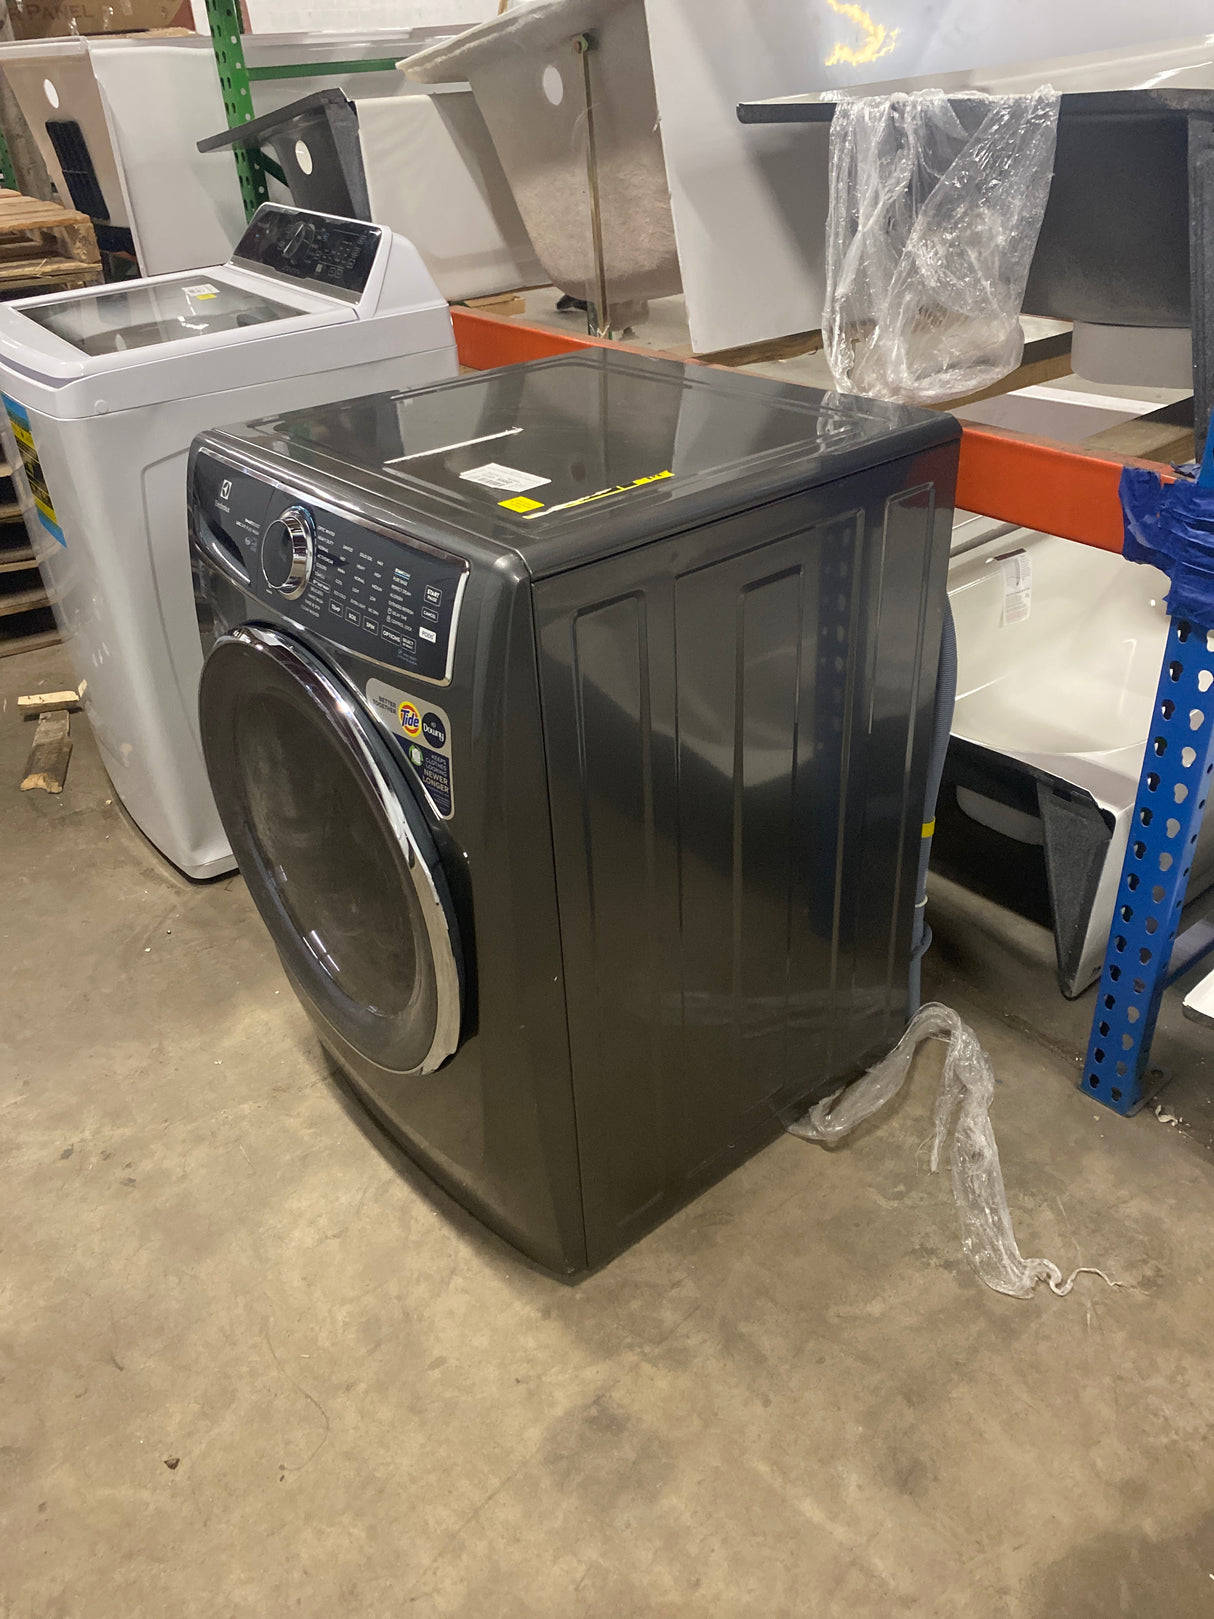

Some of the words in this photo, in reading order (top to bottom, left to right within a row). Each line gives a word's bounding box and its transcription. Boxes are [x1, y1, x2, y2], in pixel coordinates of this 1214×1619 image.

[426, 588, 440, 599] START
[383, 630, 401, 643] OPTIONS
[401, 709, 420, 728] Tide
[423, 722, 445, 742] Downy
[422, 775, 450, 794] LONGER
[423, 768, 449, 786] NEWER
